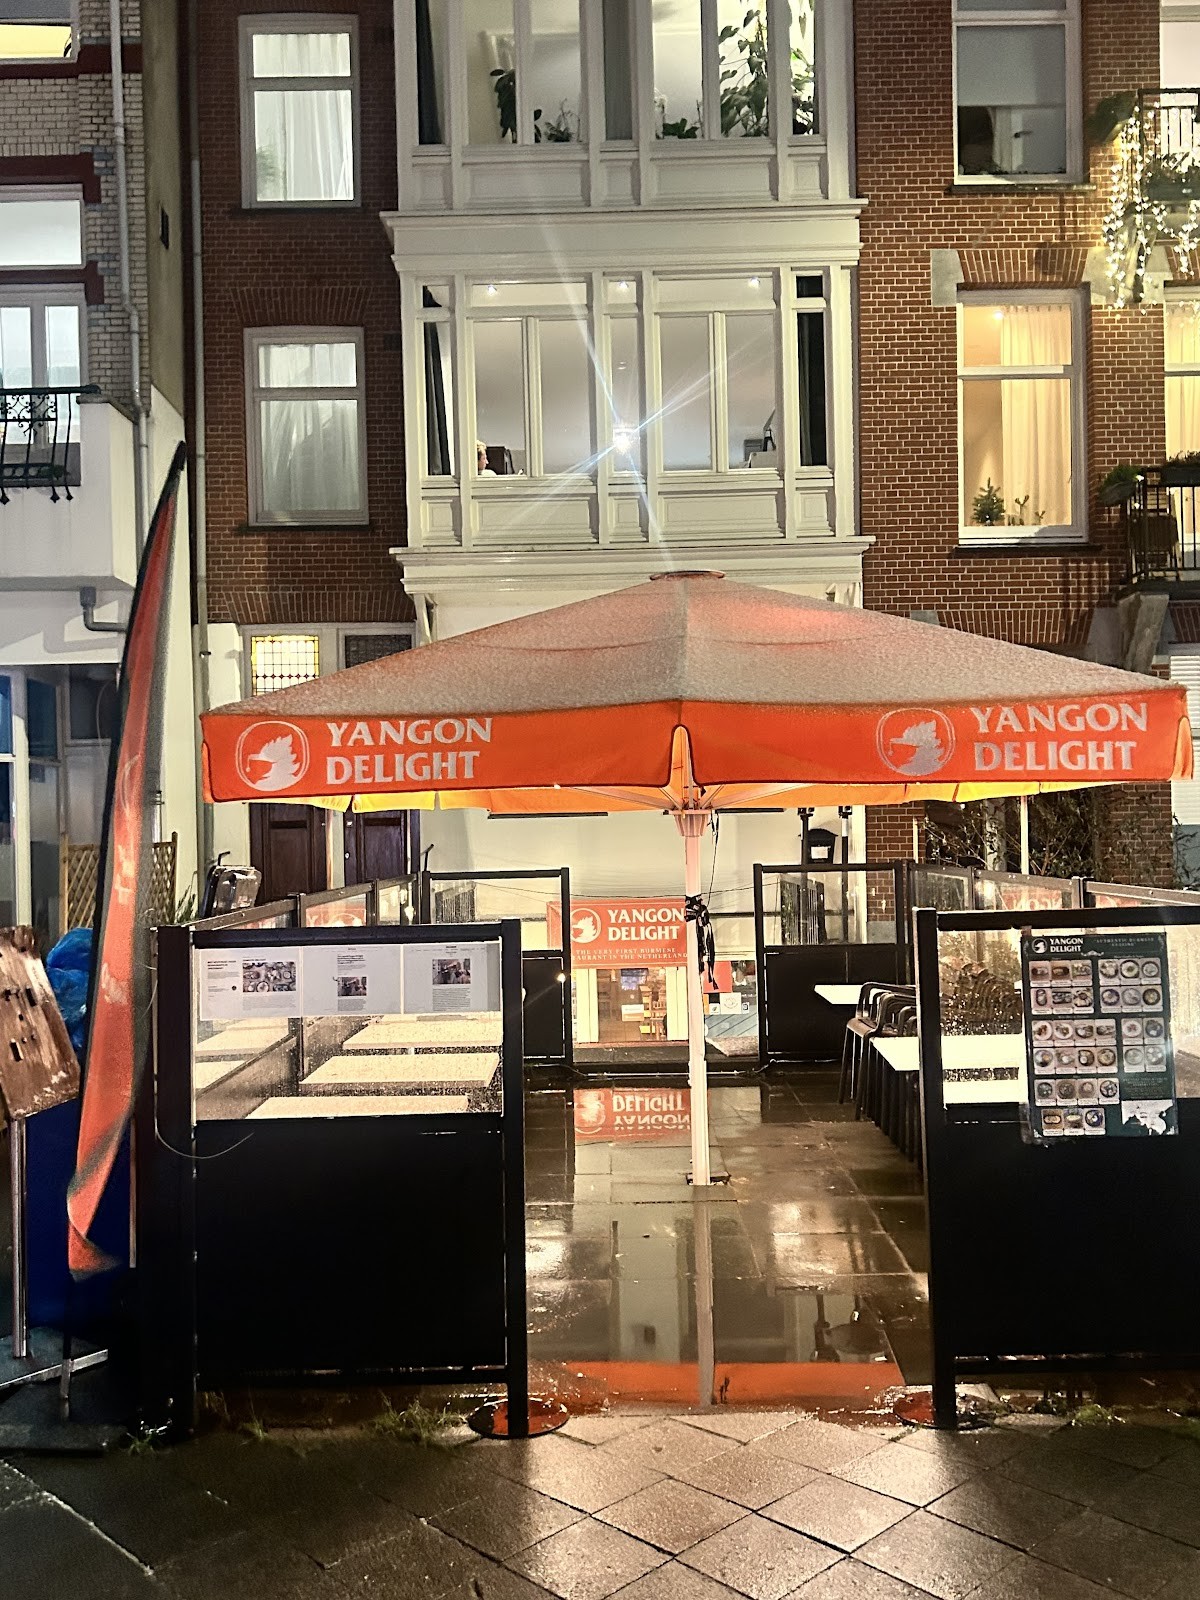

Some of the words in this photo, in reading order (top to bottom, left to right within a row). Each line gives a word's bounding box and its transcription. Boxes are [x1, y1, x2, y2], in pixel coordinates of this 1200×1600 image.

[326, 717, 493, 748] YANGON
[969, 702, 1149, 734] YANGON
[326, 750, 481, 785] DELIGHT
[973, 740, 1138, 771] DELIGHT
[608, 908, 686, 924] YANGON
[608, 925, 680, 941] DELIGHT
[1050, 937, 1084, 945] YANGON
